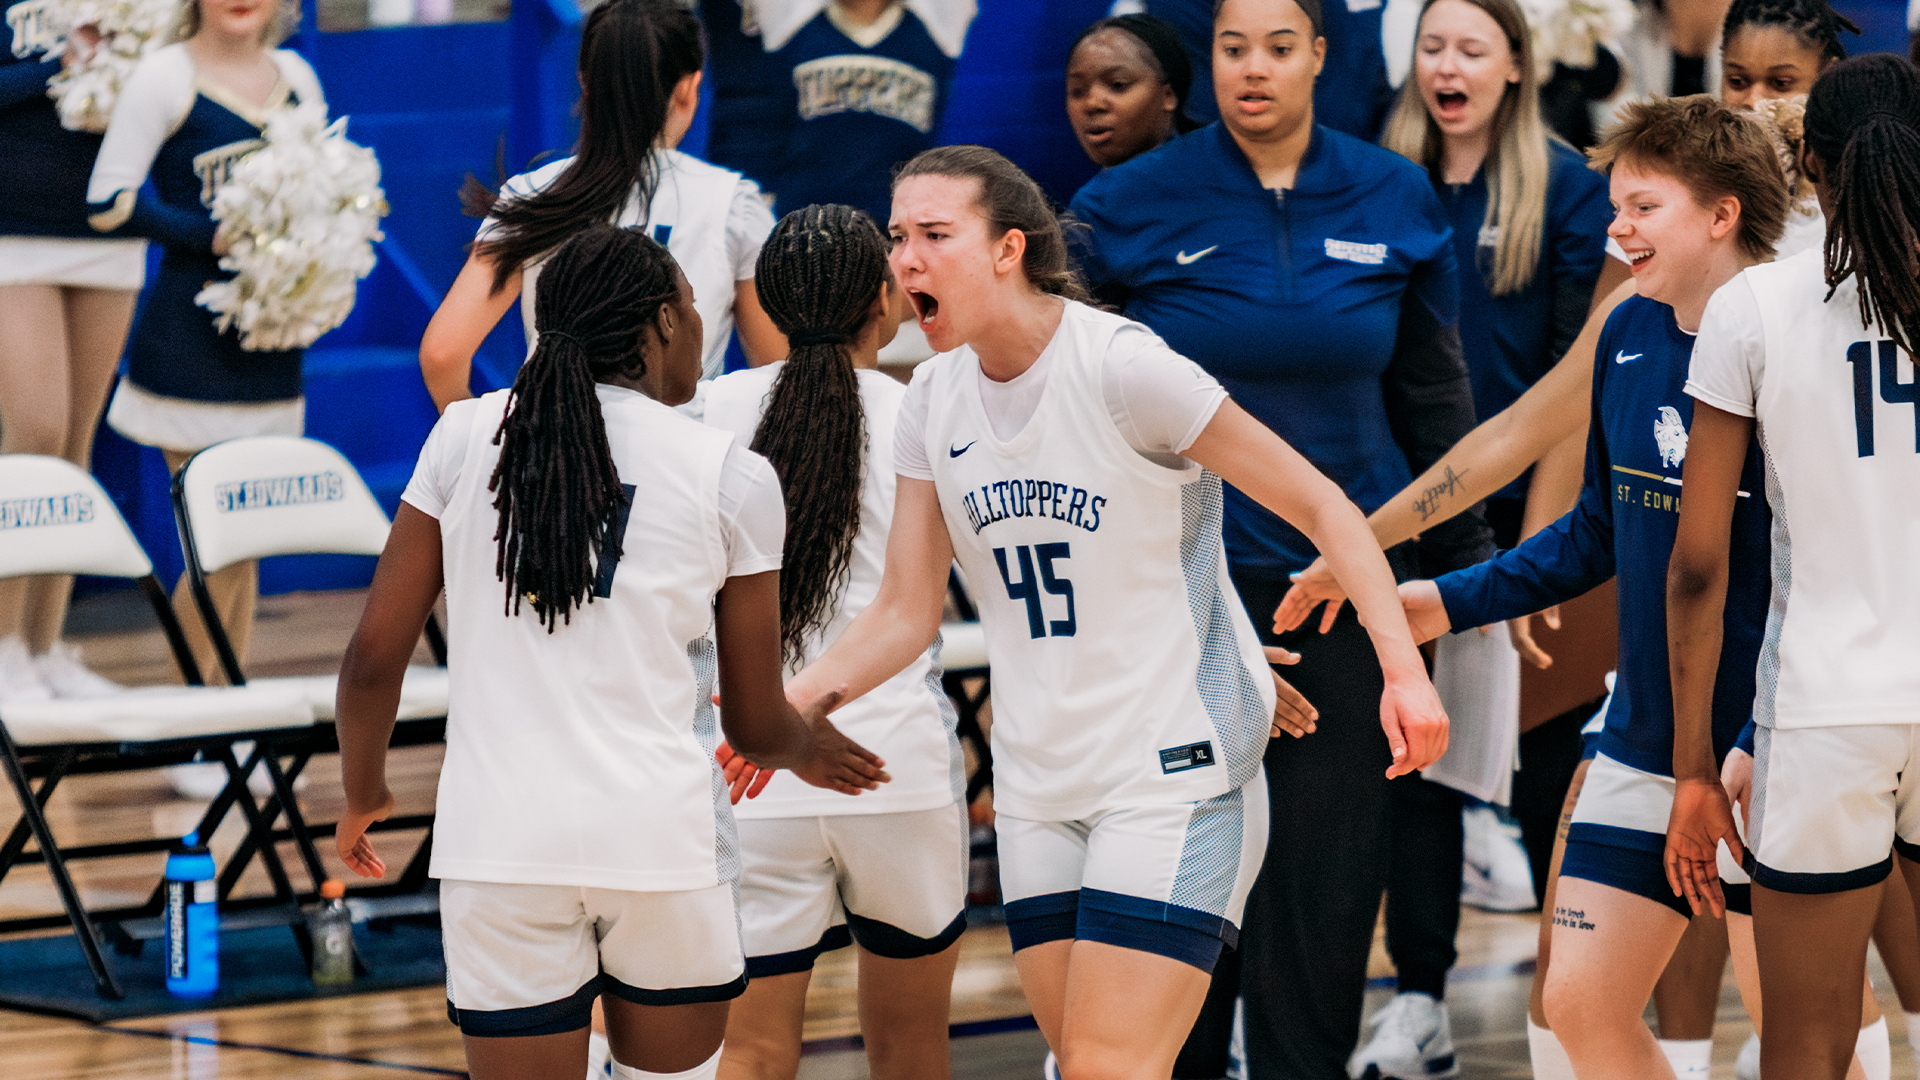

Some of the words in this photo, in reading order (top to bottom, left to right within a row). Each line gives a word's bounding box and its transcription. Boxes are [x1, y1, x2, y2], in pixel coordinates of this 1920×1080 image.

[1846, 339, 1920, 458] 14
[1617, 483, 1637, 505] ST.
[992, 541, 1077, 640] 45
[1195, 749, 1208, 760] XL
